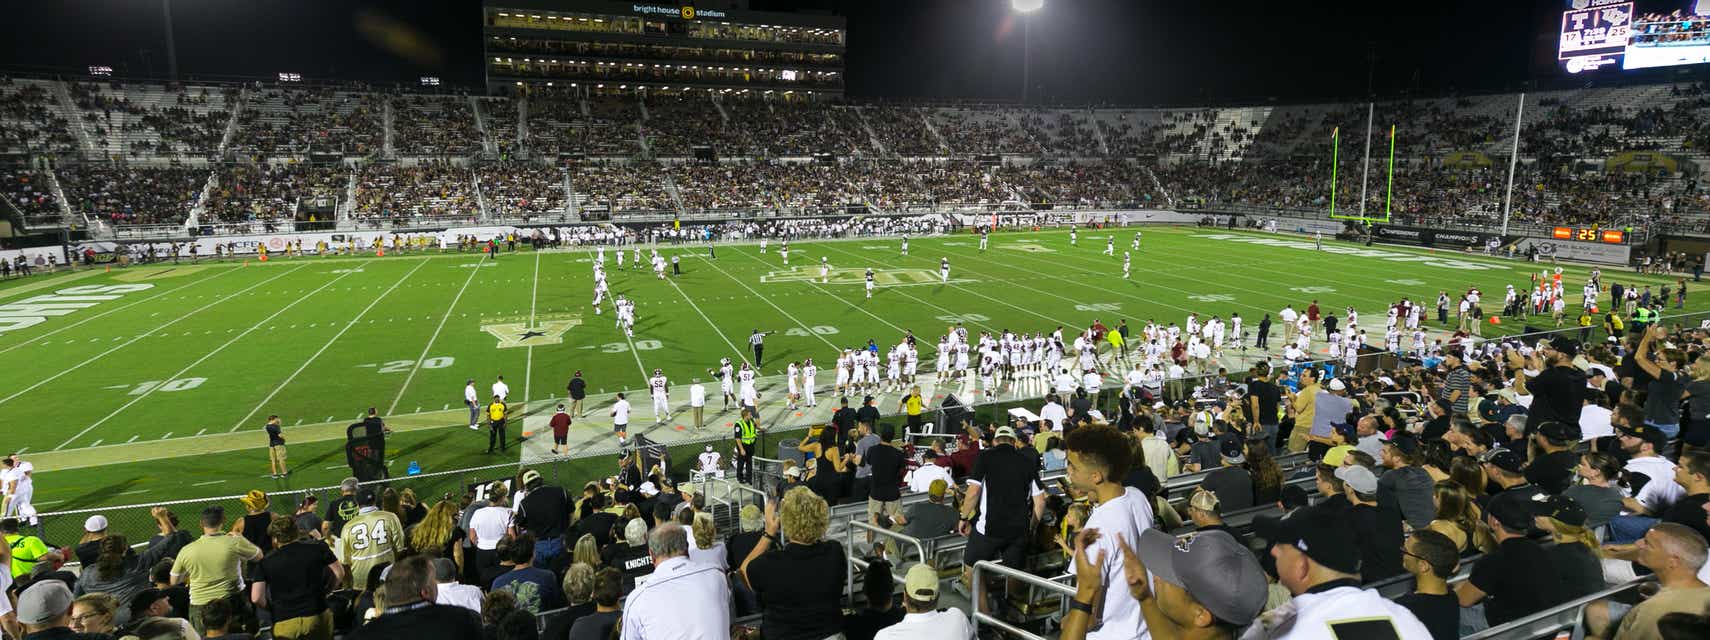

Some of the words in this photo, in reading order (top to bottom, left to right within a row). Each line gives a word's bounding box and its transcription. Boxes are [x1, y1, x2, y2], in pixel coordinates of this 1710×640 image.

[633, 5, 656, 14] bright
[657, 6, 680, 15] house
[696, 9, 725, 17] stadium
[1578, 229, 1596, 241] 25
[785, 325, 840, 337] 40
[601, 340, 664, 353] 30
[378, 356, 456, 374] 20
[128, 377, 208, 396] 10
[654, 380, 664, 388] 52
[351, 519, 388, 550] 34
